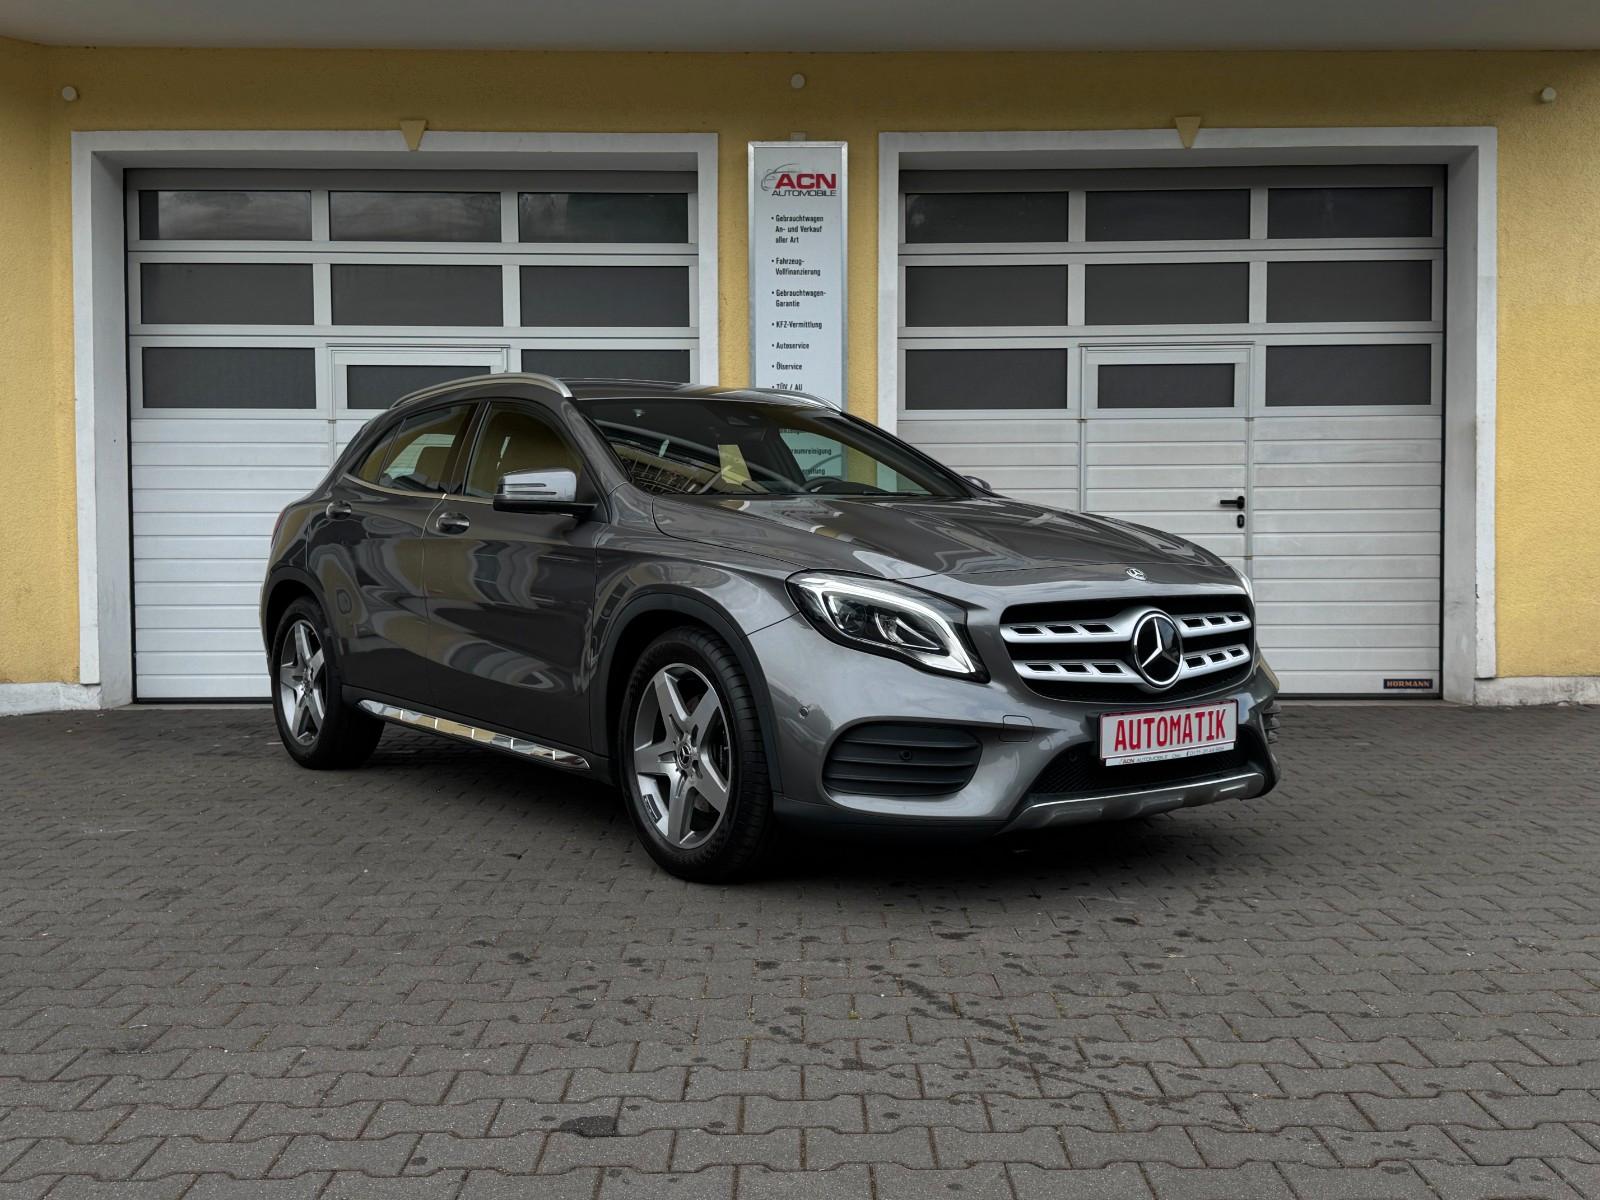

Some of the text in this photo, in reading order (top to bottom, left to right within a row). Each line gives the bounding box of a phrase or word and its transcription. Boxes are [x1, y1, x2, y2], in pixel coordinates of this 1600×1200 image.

[775, 174, 836, 189] ACN
[776, 214, 824, 223] Gebrauchtwagen
[776, 258, 805, 266] Fahrzeug-
[776, 268, 820, 276] Vollfinanzierung
[776, 289, 826, 298] Gebrauchtwagen-
[776, 321, 822, 330] KFZ-Vermittlung
[776, 362, 802, 370] Ölservice
[776, 382, 788, 390] TÜV
[1114, 709, 1226, 752] AUTOMATIK
